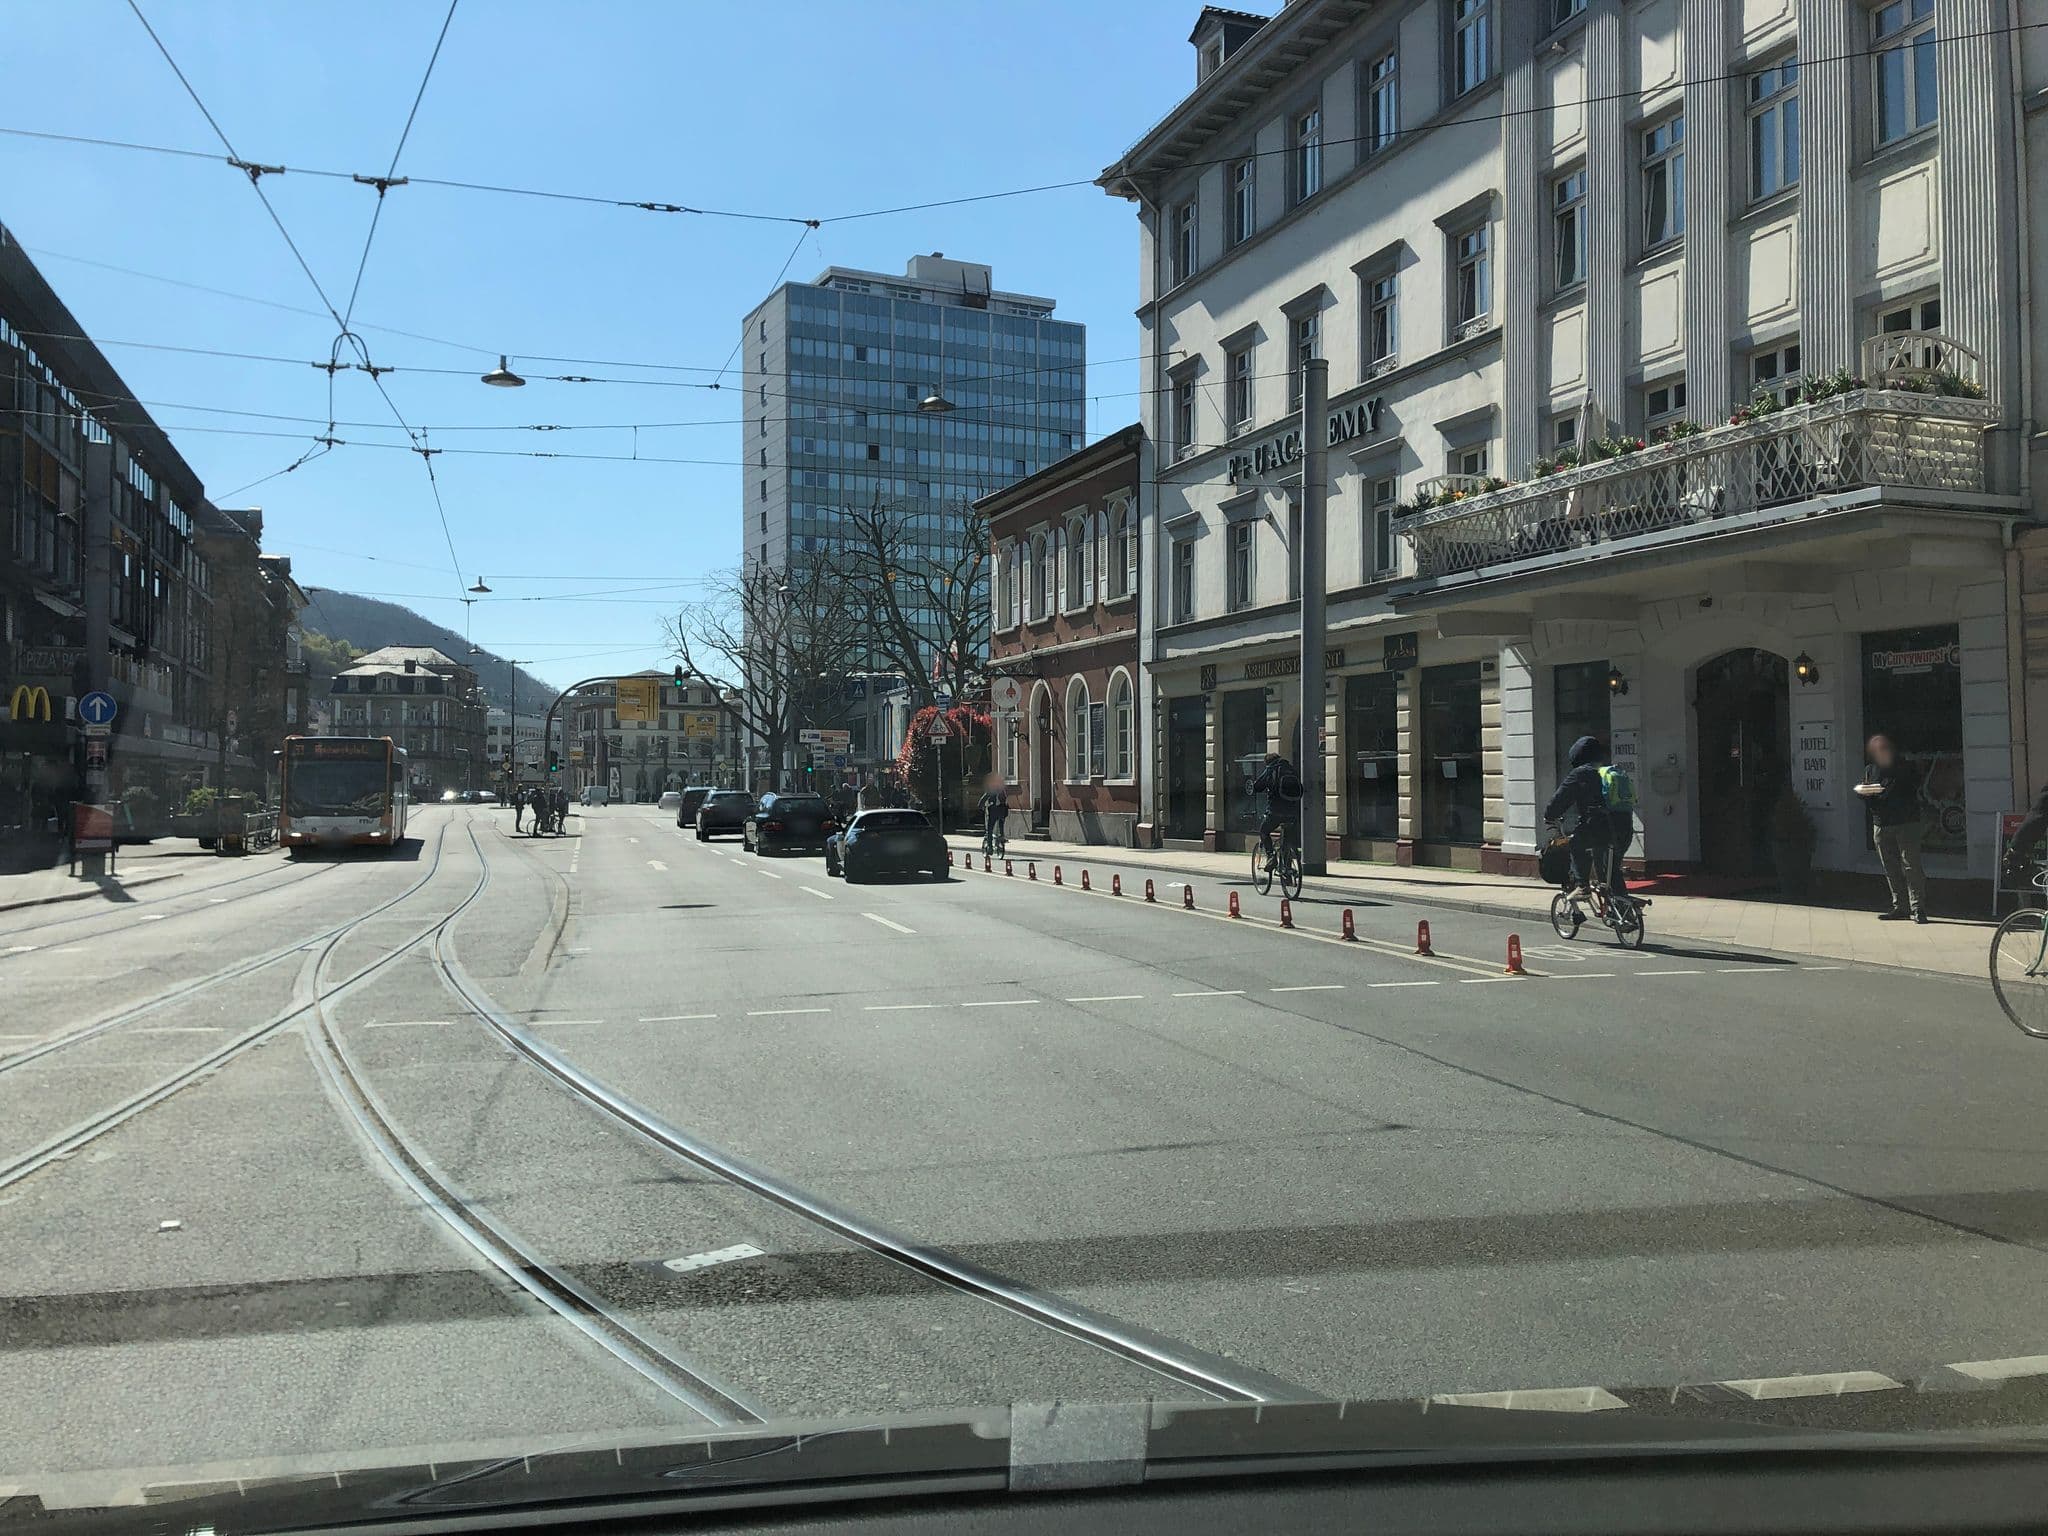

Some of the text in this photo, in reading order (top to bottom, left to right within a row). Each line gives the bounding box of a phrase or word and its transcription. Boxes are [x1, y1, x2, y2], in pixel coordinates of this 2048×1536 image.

[1227, 396, 1381, 484] F+U ACAEMY
[1615, 744, 1638, 755] HOTEL
[1800, 737, 1829, 751] HOTEL
[1804, 758, 1826, 771] BAYR
[1807, 778, 1825, 792] HOF
